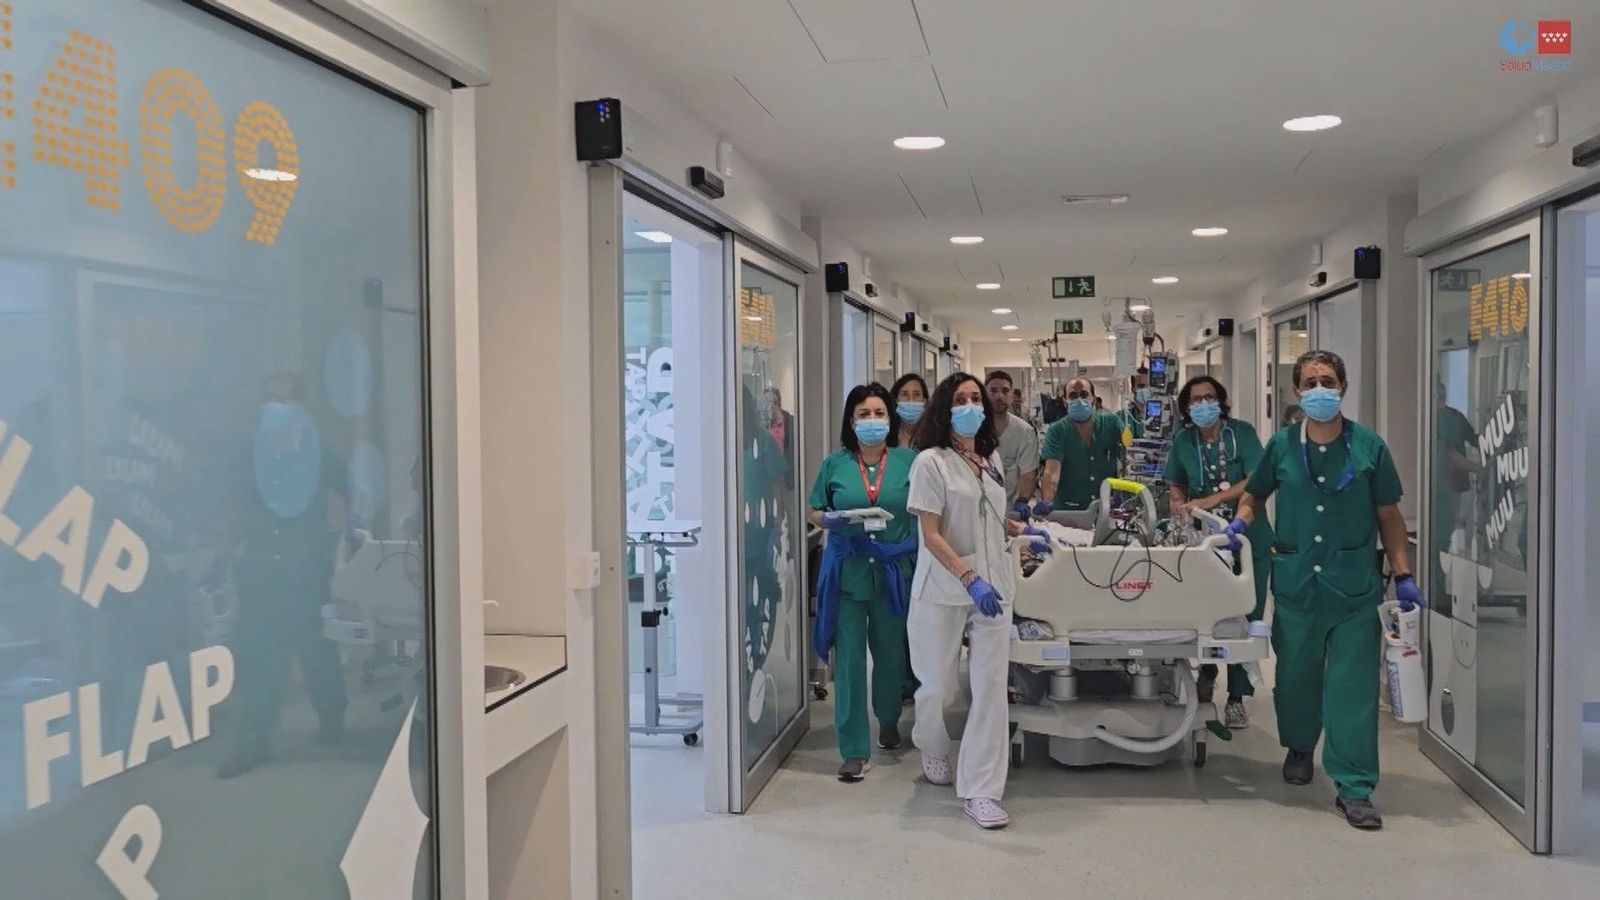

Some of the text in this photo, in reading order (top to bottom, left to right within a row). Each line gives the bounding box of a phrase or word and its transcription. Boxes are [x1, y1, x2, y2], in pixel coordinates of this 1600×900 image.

[0, 0, 299, 246] 409
[1478, 394, 1515, 467] MUU
[1497, 446, 1528, 484] MUU
[0, 420, 150, 609] LAP
[1486, 489, 1514, 549] MUU
[1115, 581, 1153, 590] LINET
[23, 645, 235, 809] FLAP
